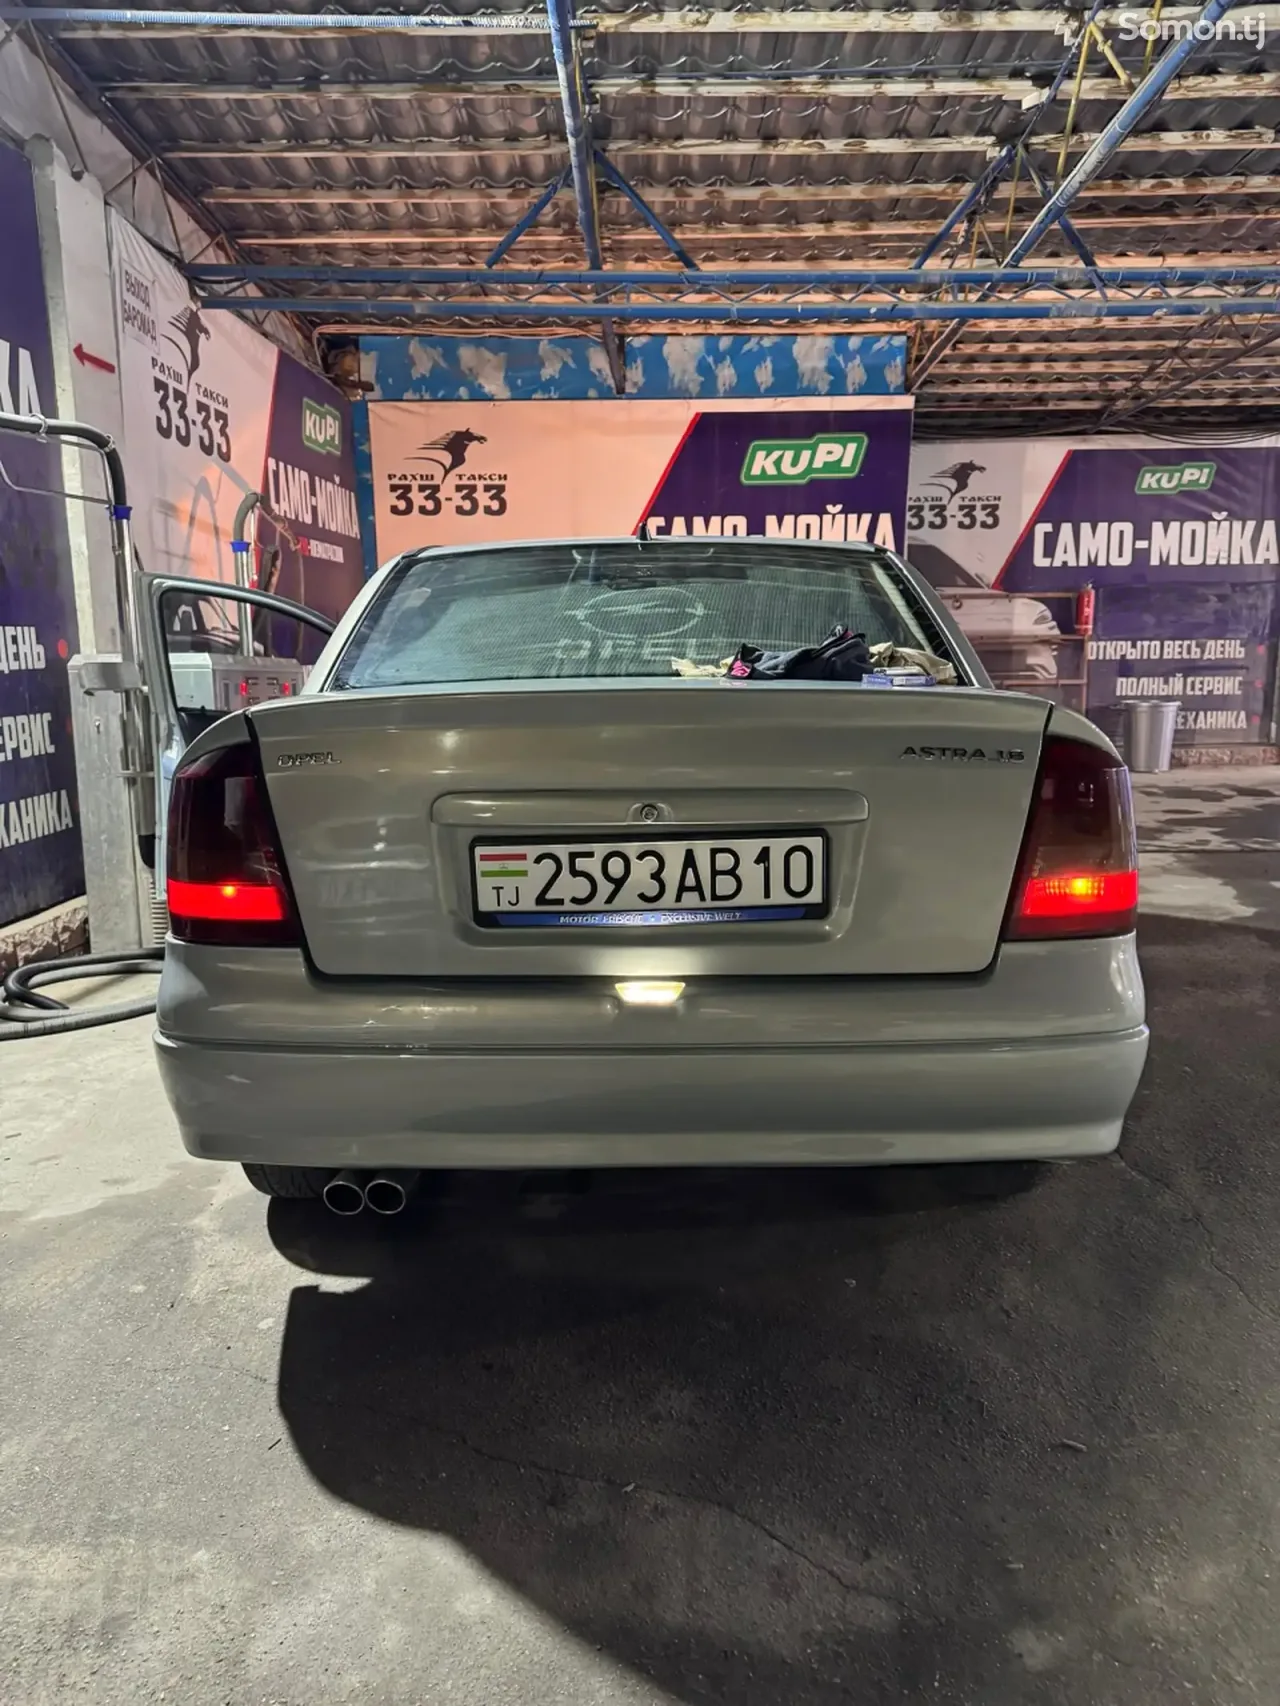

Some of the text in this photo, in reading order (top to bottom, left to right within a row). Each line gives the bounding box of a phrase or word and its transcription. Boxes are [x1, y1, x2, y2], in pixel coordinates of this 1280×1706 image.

[124, 269, 151, 312] ВЫХОД
[195, 381, 229, 409] ТАКСИ
[153, 375, 232, 463] 33-33
[305, 408, 339, 445] KUPI
[750, 442, 858, 475] KUPI
[455, 473, 508, 481] ТАКСИ
[1141, 467, 1210, 489] KUPI
[268, 456, 360, 540] САМО-МОЙКА
[389, 483, 507, 516] 33-33
[959, 494, 1002, 502] ТАКСИ
[647, 503, 897, 552] МОЙКА
[907, 503, 1000, 530] 33-33
[1033, 511, 1279, 567] САМО-МОЙКА
[1088, 639, 1246, 660] ОТКРЫТО ВЕСЬ ДЕНЬ
[1115, 673, 1243, 696] ПОЛНЫЙ СЕРВИС
[1176, 710, 1248, 729] ЕХАНИКА
[277, 751, 342, 768] OPEL
[900, 746, 988, 762] ASTRA
[532, 844, 814, 906] 2593AB10
[492, 886, 520, 907] TJ
